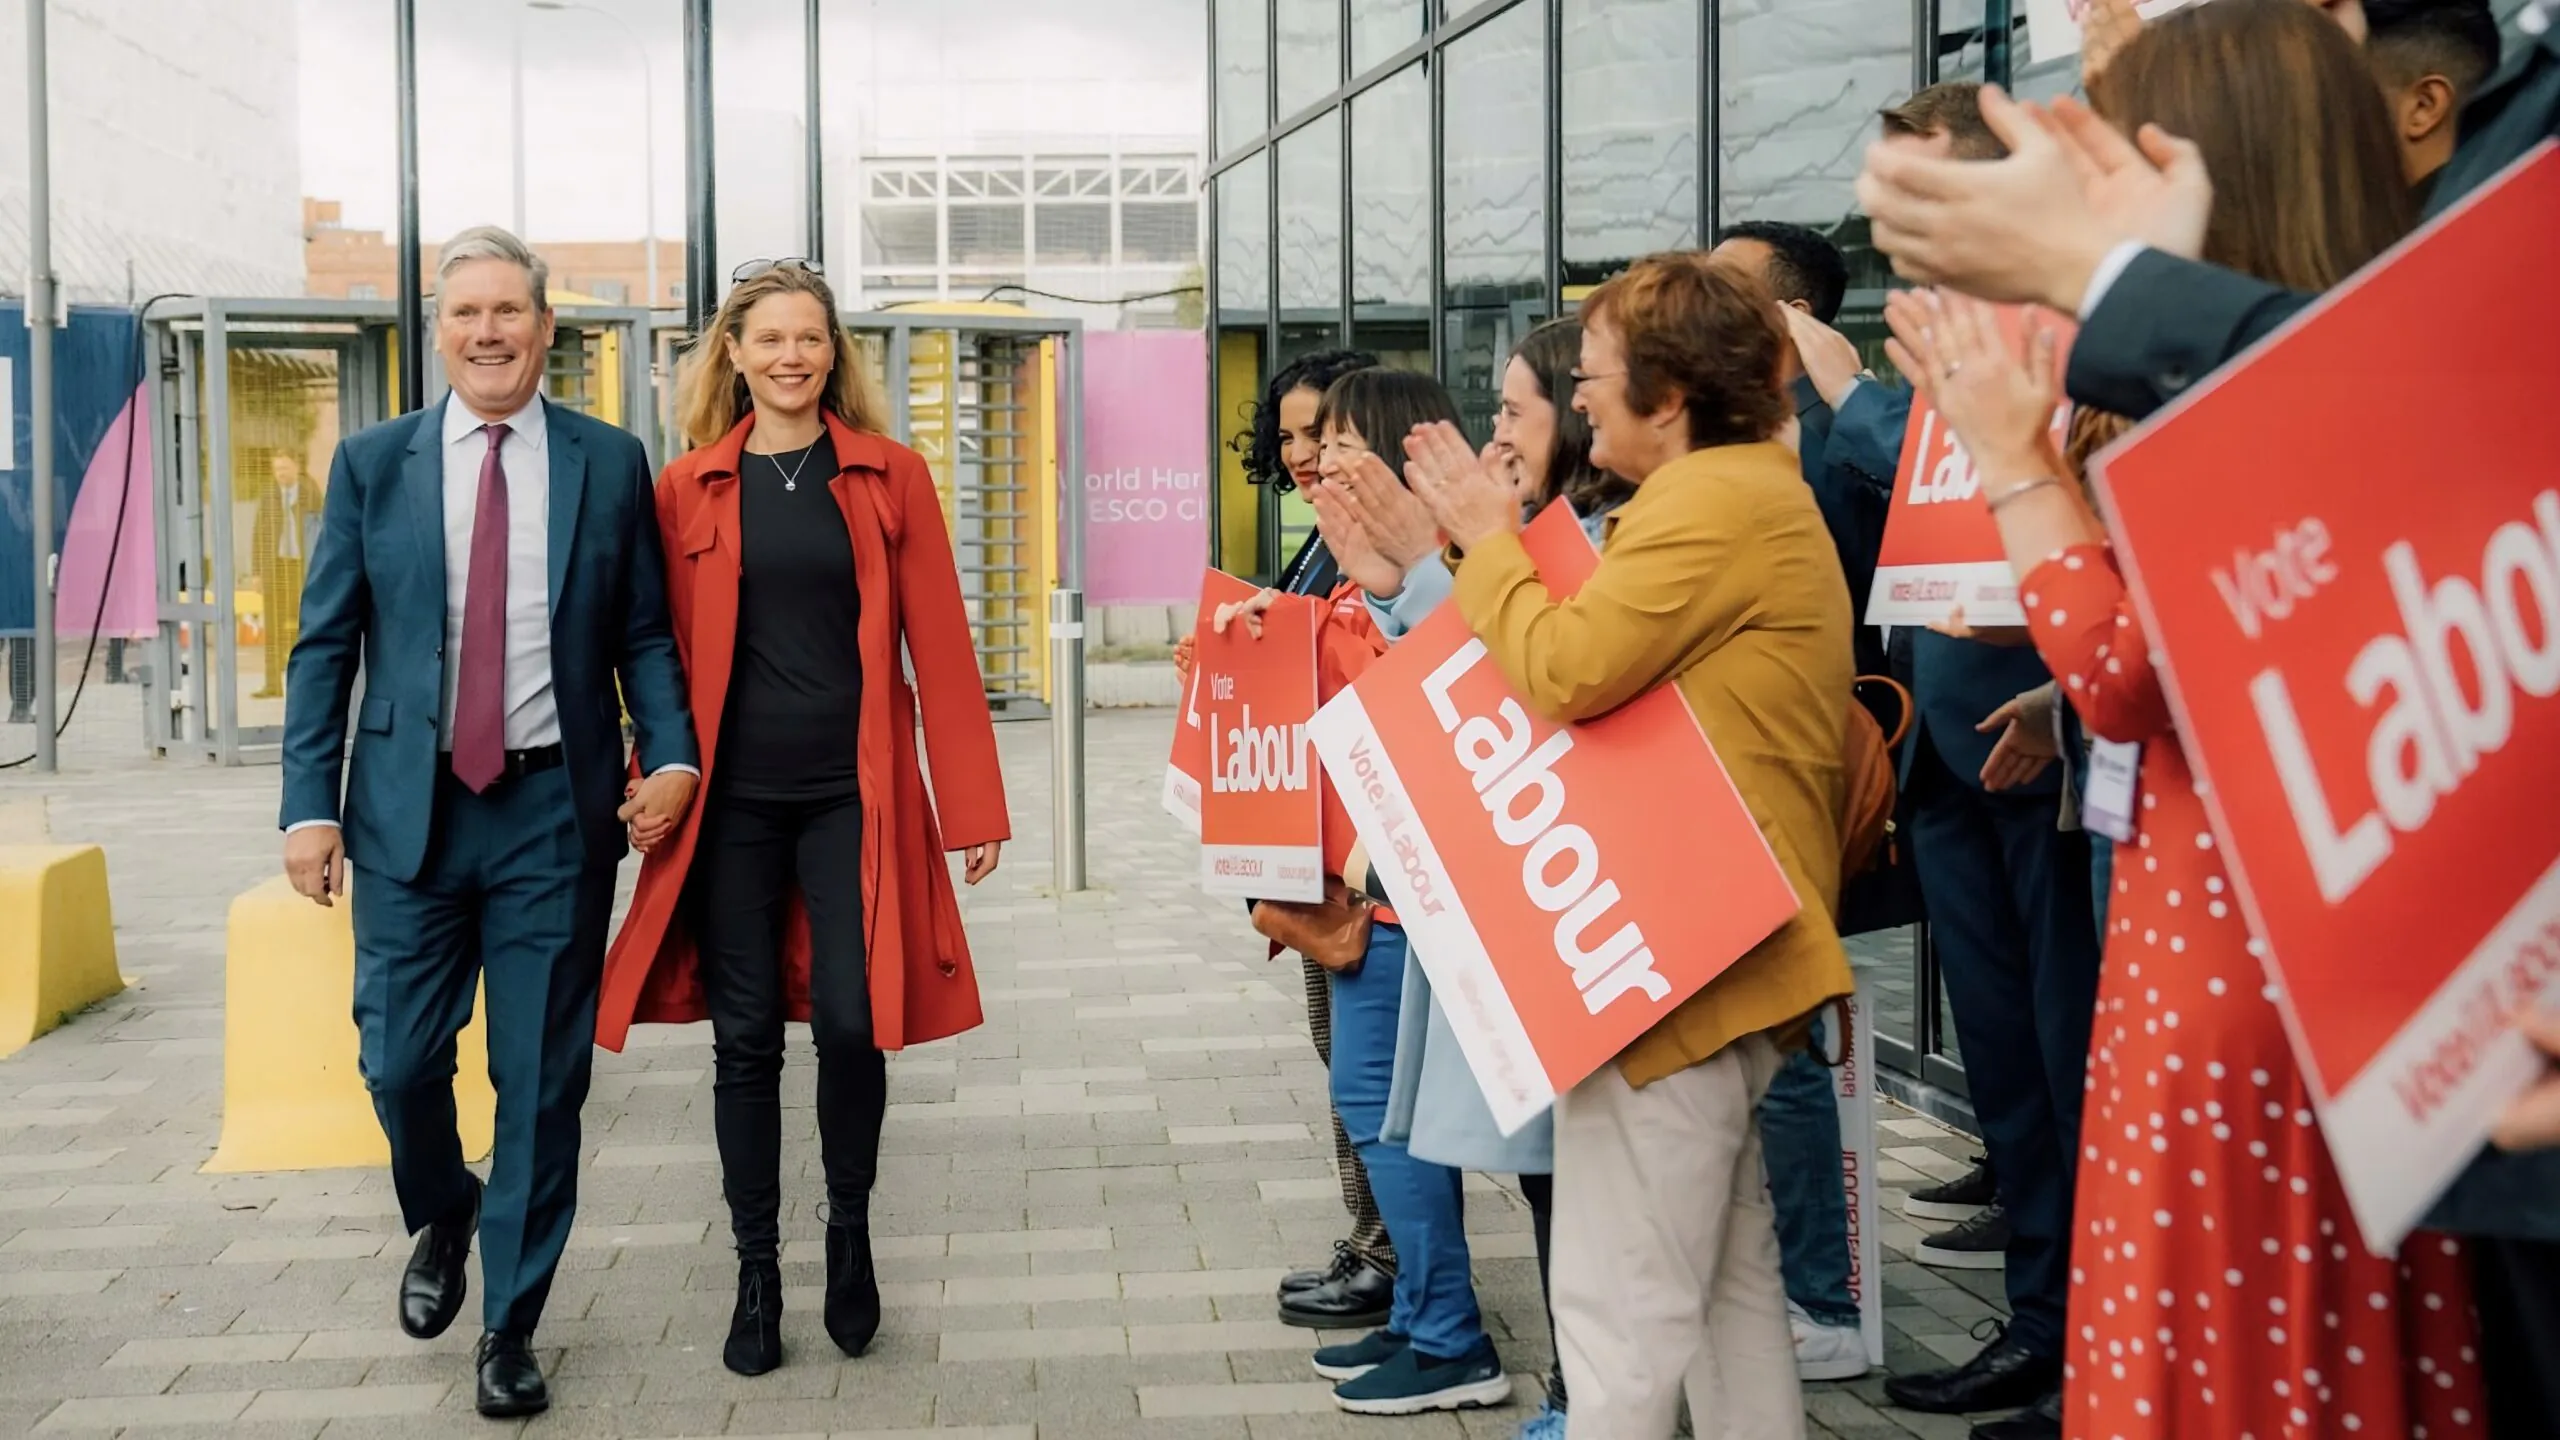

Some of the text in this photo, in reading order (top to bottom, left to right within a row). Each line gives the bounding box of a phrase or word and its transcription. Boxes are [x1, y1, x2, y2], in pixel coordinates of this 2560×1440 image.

[1058, 497, 1168, 523] ESCO
[2210, 515, 2339, 641] Vote
[1211, 673, 1233, 700] Vote
[1211, 703, 1309, 792] Labour
[1348, 734, 1446, 917] Vote Labour
[1420, 636, 1673, 1016] Labour
